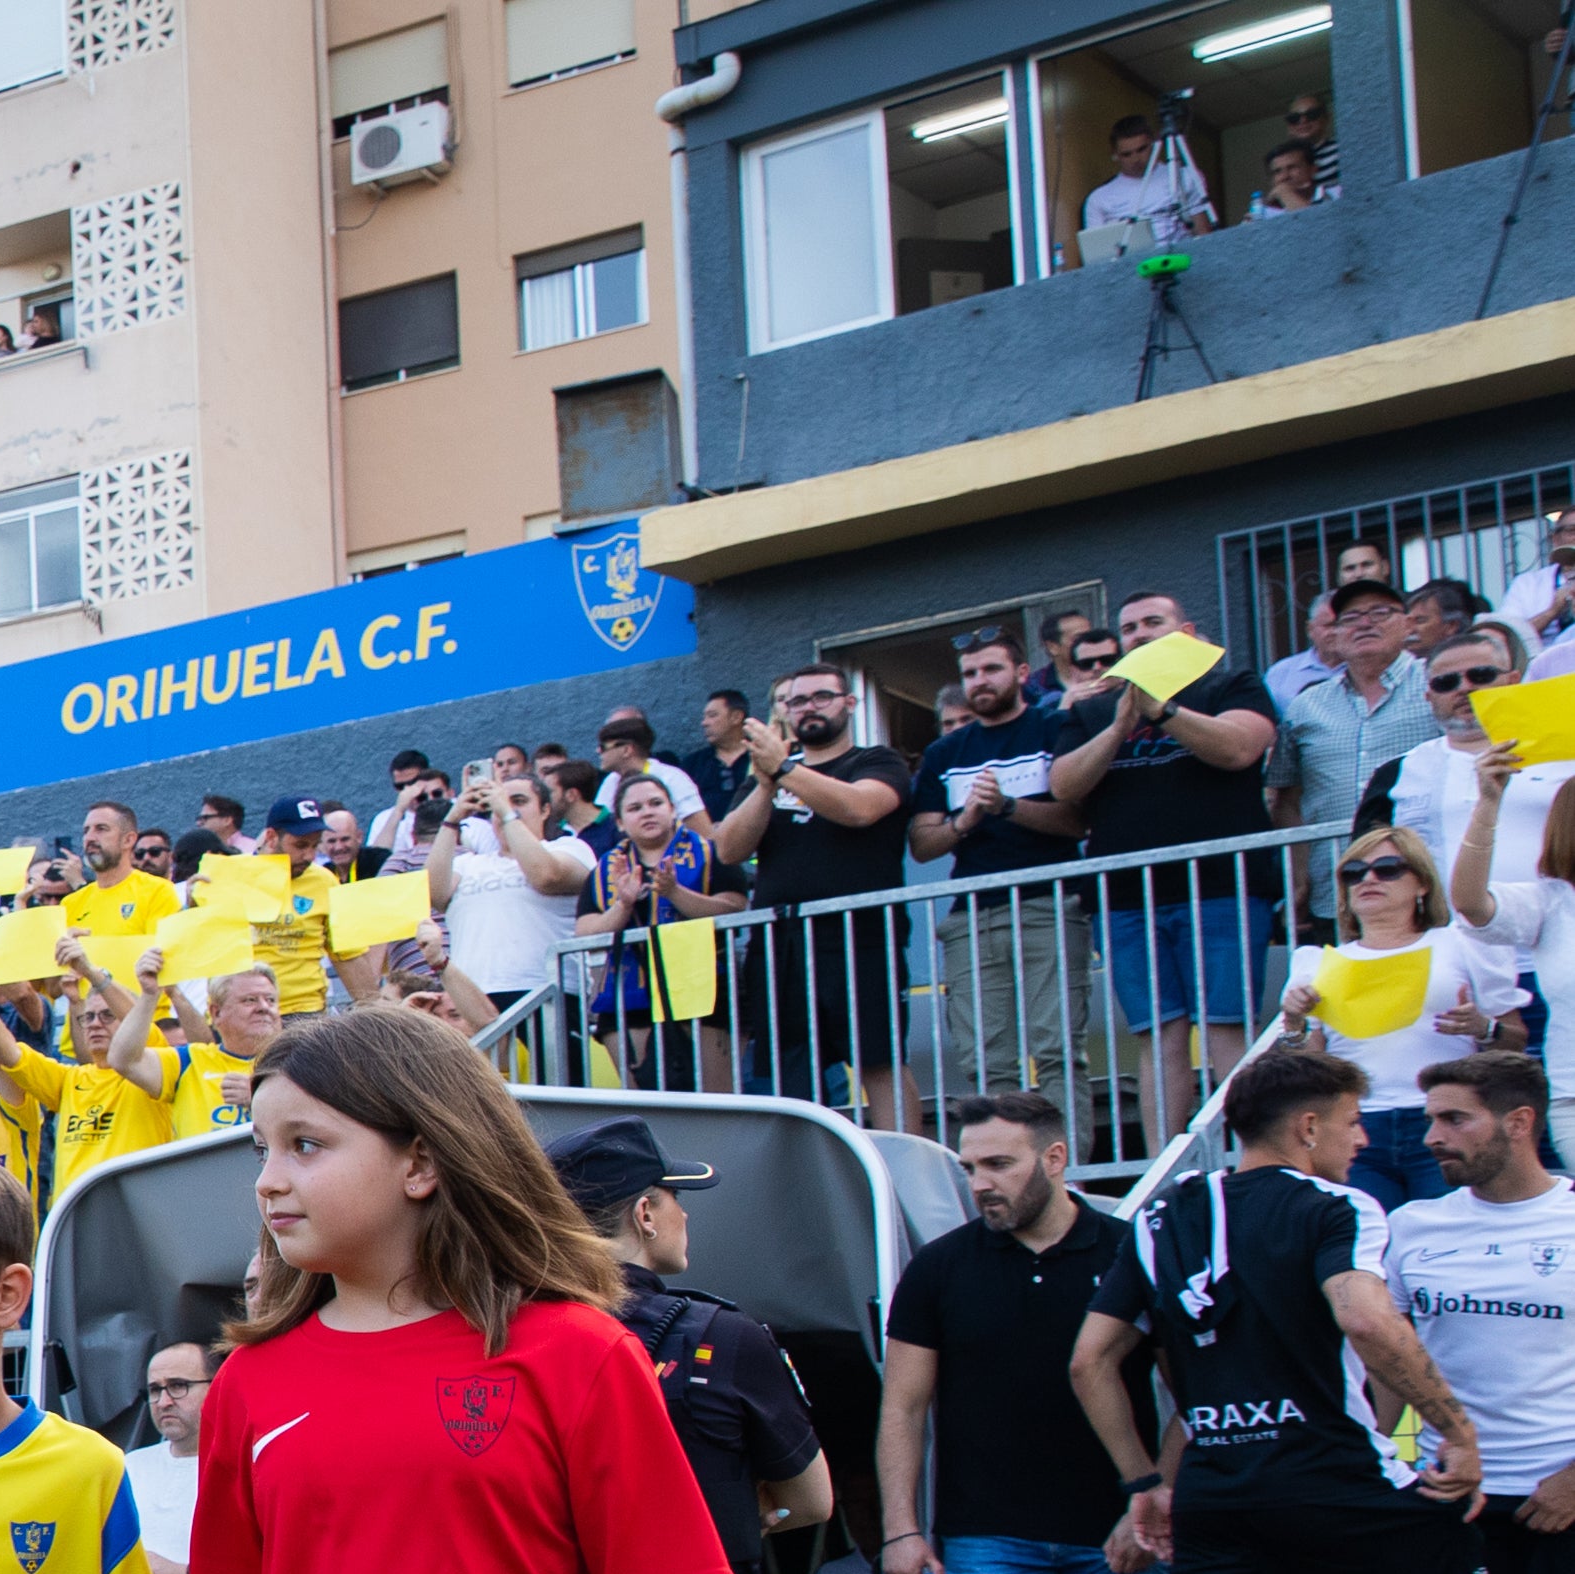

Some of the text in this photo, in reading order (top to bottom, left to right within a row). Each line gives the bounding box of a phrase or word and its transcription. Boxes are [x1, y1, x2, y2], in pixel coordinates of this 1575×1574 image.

[61, 602, 457, 735] ORIHUELA C.F.
[1431, 1291, 1565, 1320] johnson
